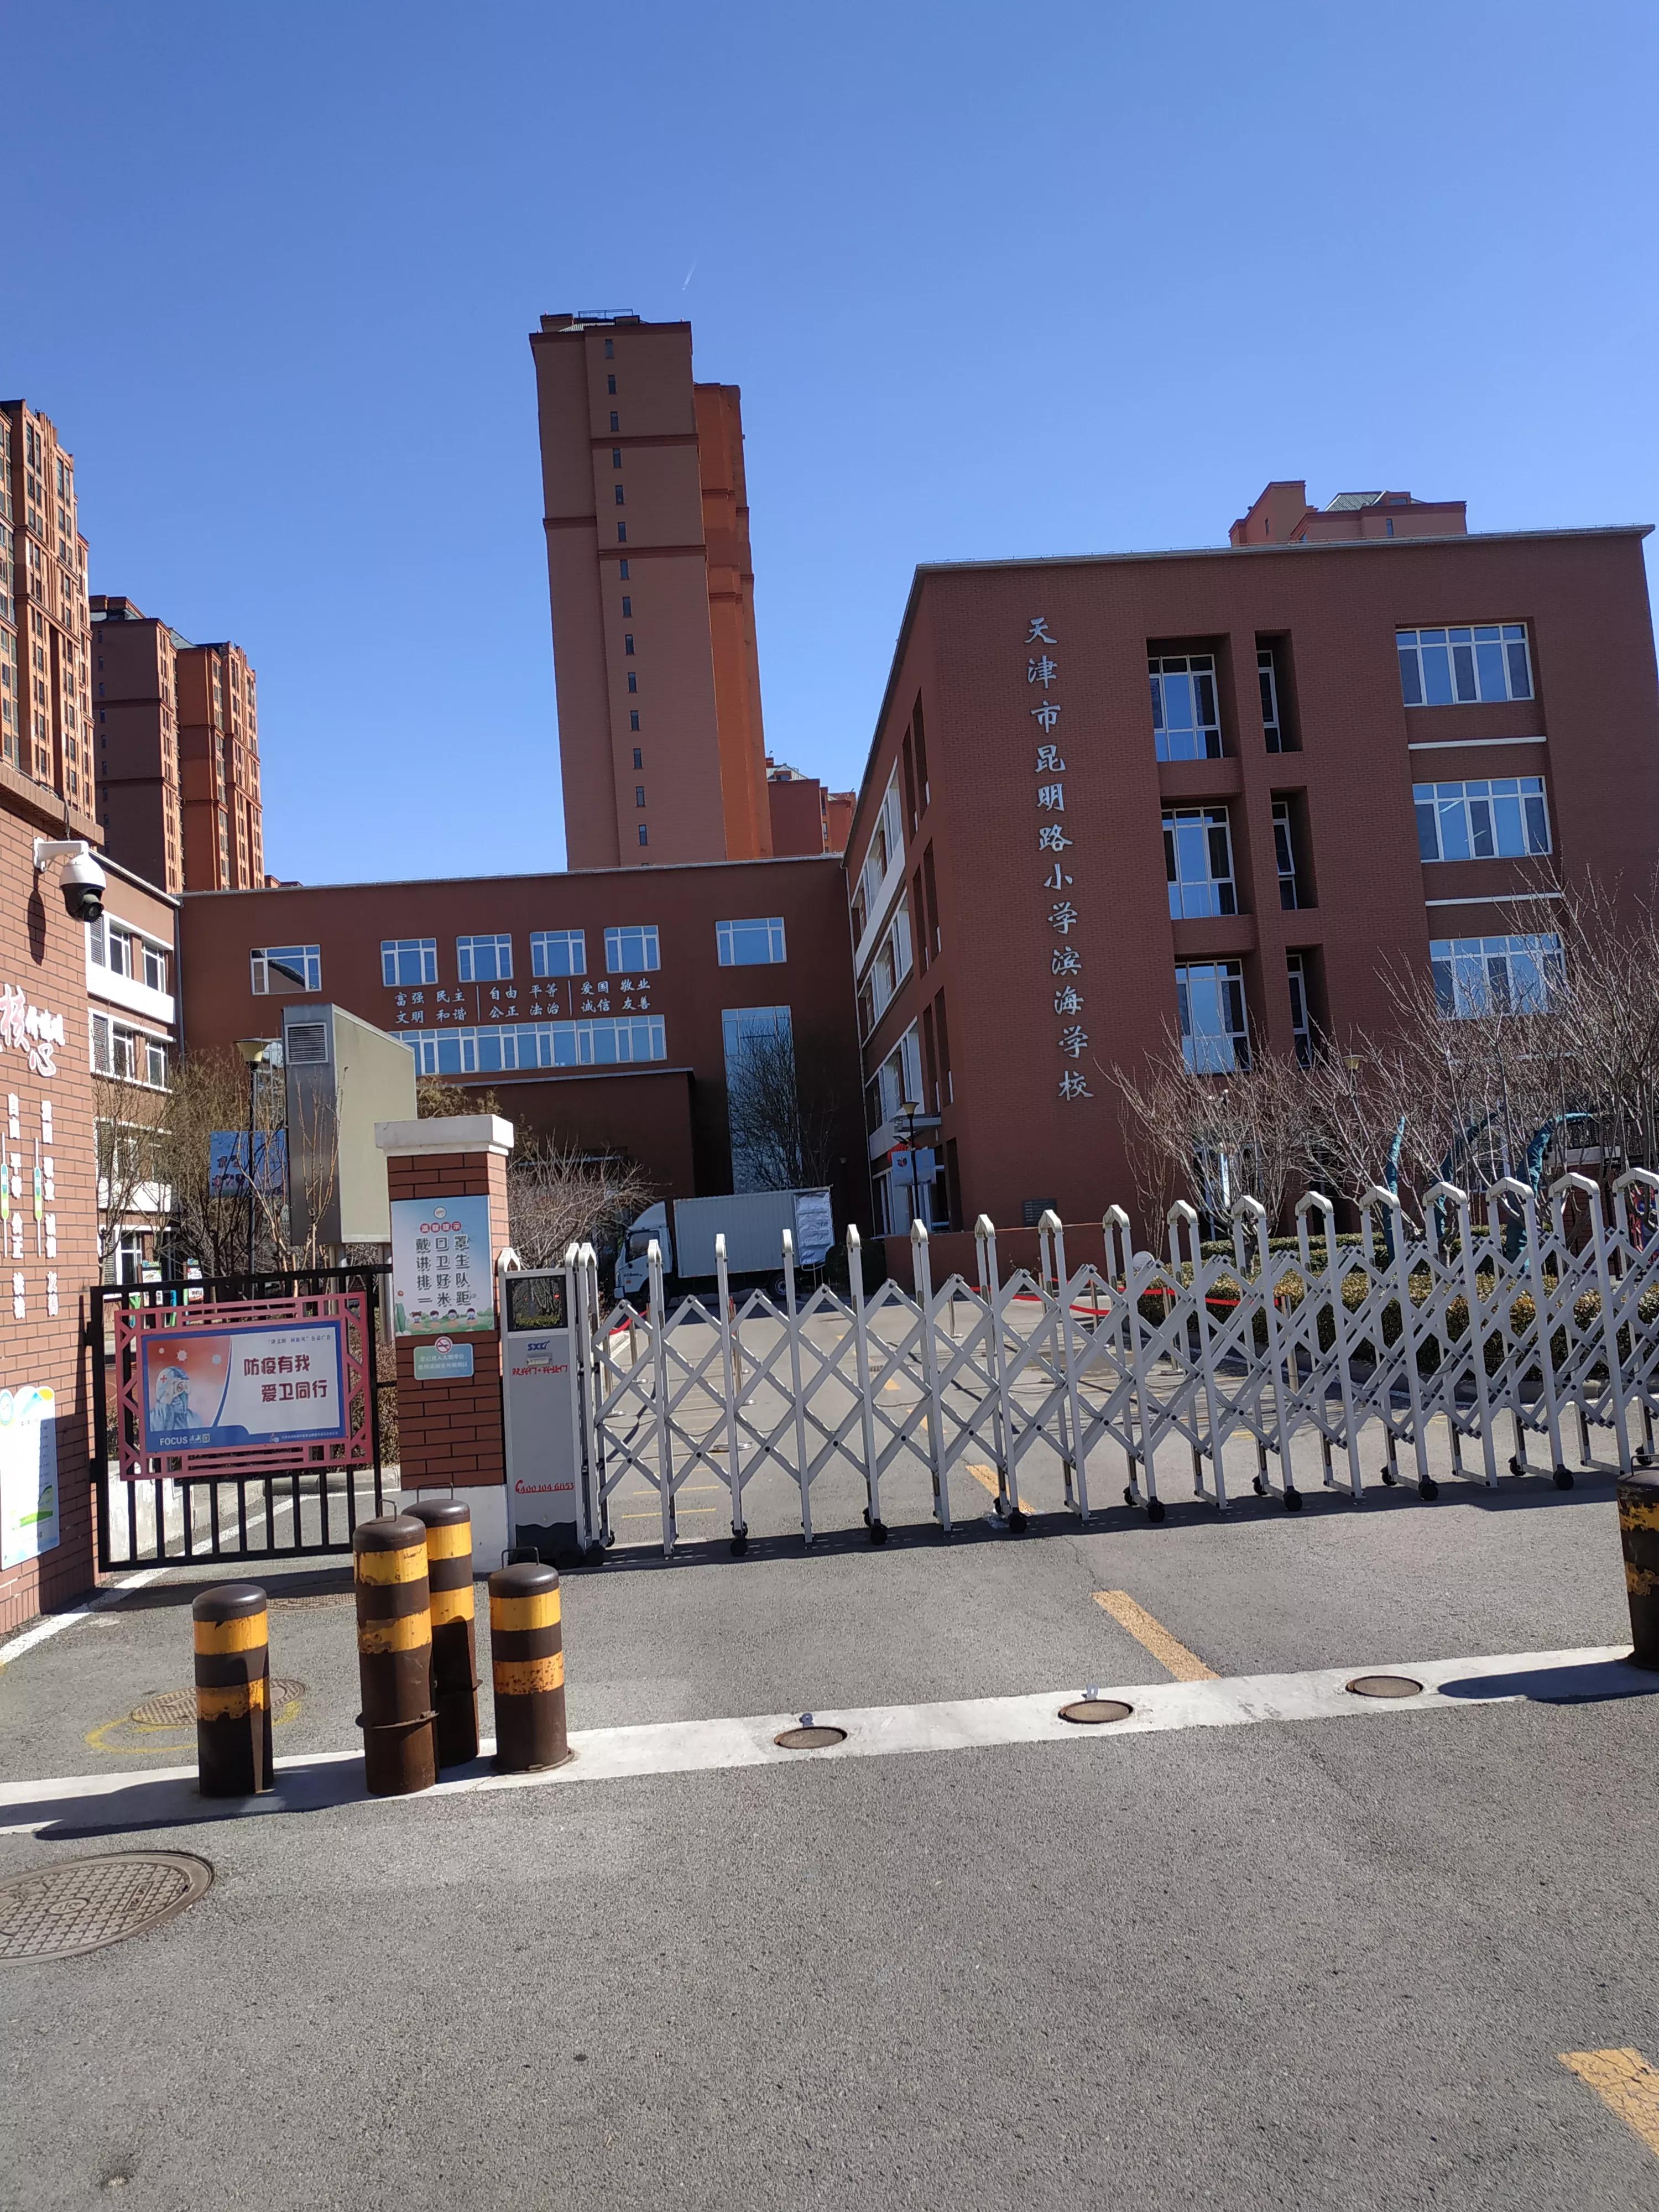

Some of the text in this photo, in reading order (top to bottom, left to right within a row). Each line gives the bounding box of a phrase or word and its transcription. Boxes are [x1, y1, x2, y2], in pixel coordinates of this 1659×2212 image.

[1024, 617, 1094, 1100] 天津市昆明路小学滨海学校
[489, 982, 558, 1000] 自由 平等
[581, 977, 651, 995] 爱国 敬业
[394, 988, 465, 1006] 富强 民主
[581, 996, 651, 1013] 诚信 友善
[394, 1006, 467, 1024] 文明 和谐
[489, 1002, 560, 1019] 公正 法治
[421, 1222, 461, 1233] 温馨提示
[415, 1235, 470, 1254] 戴口罩
[416, 1254, 470, 1272] 讲卫生
[416, 1272, 471, 1291] 排好队
[417, 1291, 471, 1307] 一米距
[243, 1354, 310, 1376] 防疫有我
[261, 1379, 328, 1403] 爱卫同行
[159, 1436, 188, 1446] FOCUS
